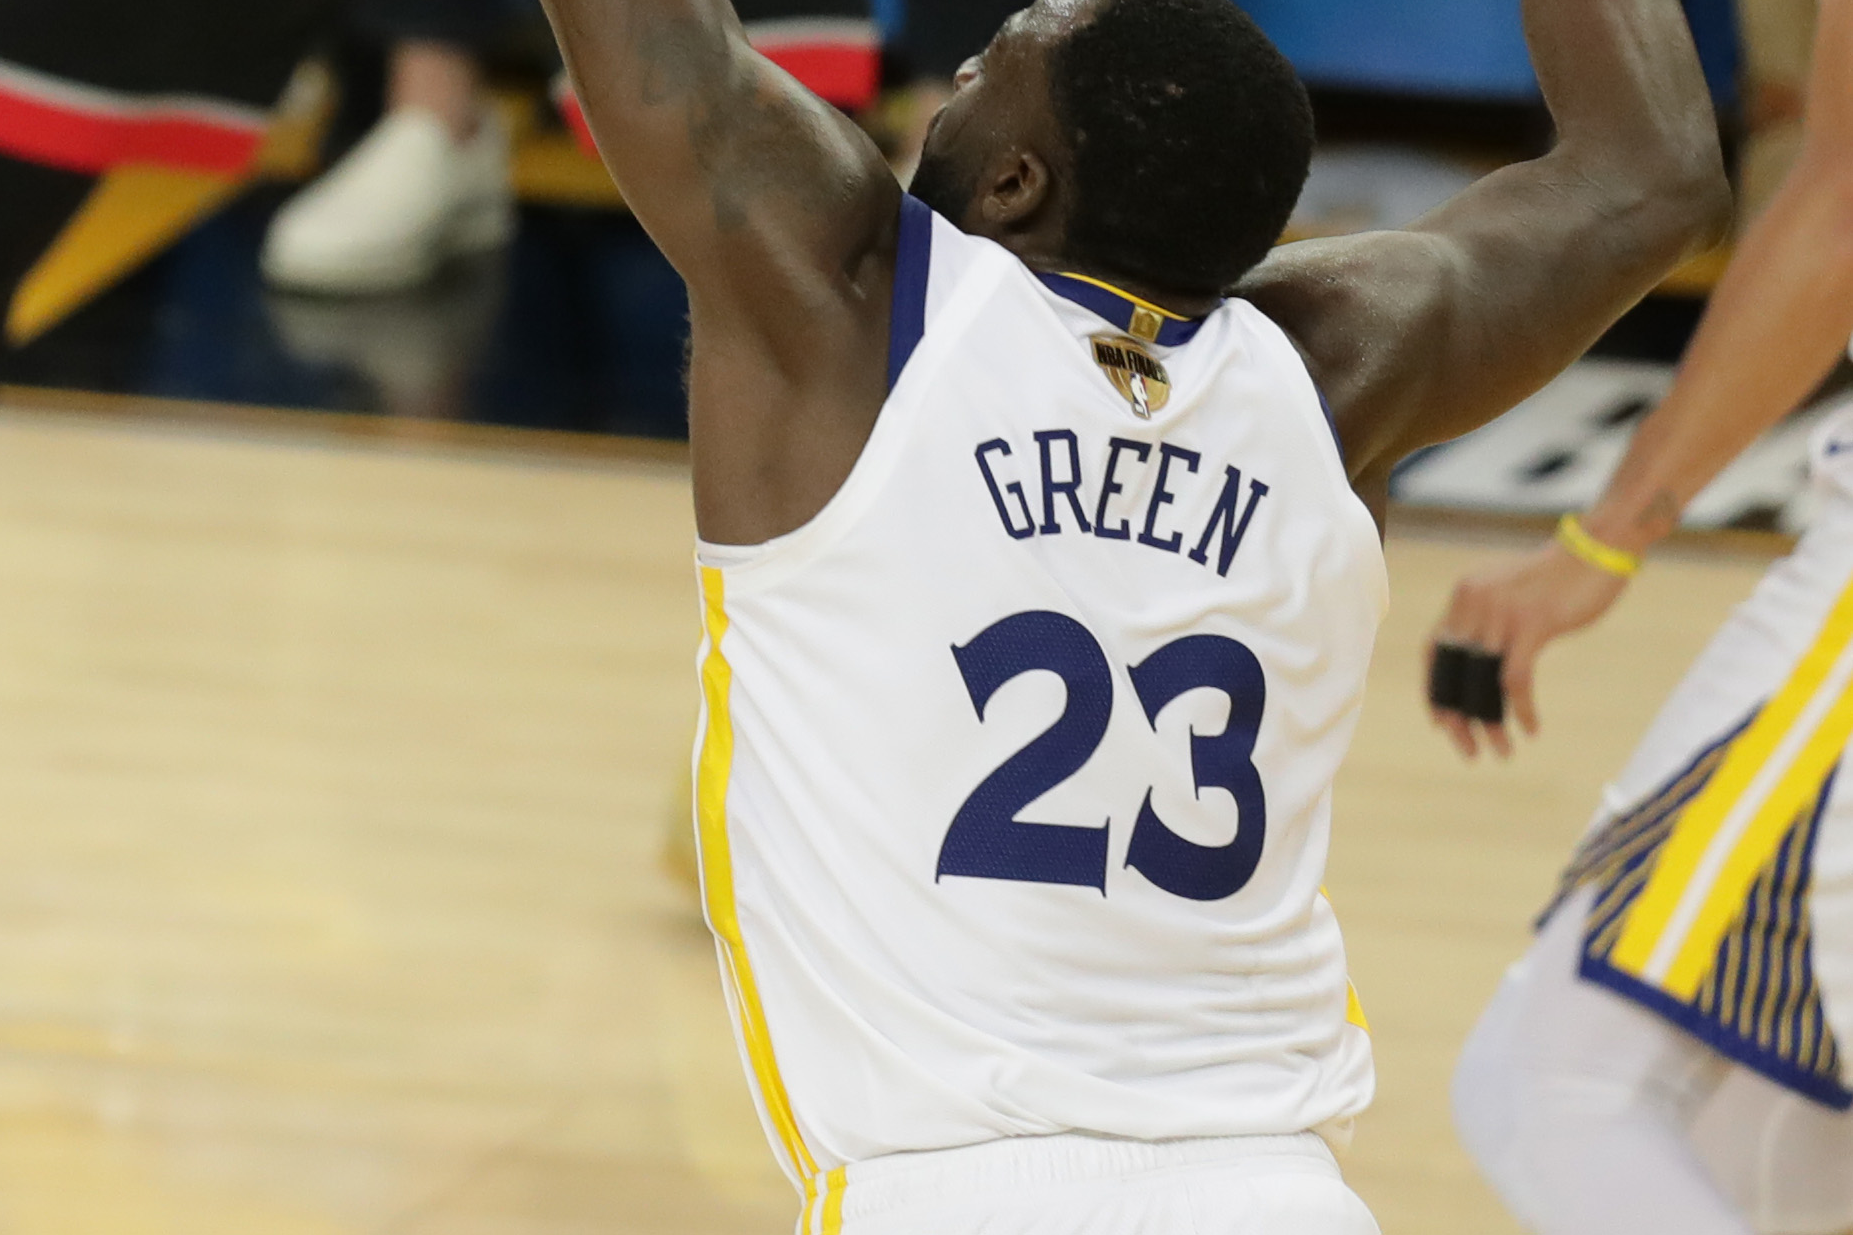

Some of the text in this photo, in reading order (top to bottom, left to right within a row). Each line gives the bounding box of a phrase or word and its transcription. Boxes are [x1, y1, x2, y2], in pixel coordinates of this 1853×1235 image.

[1094, 343, 1127, 369] NBA
[974, 429, 1269, 578] GREEN
[935, 610, 1267, 902] 23
